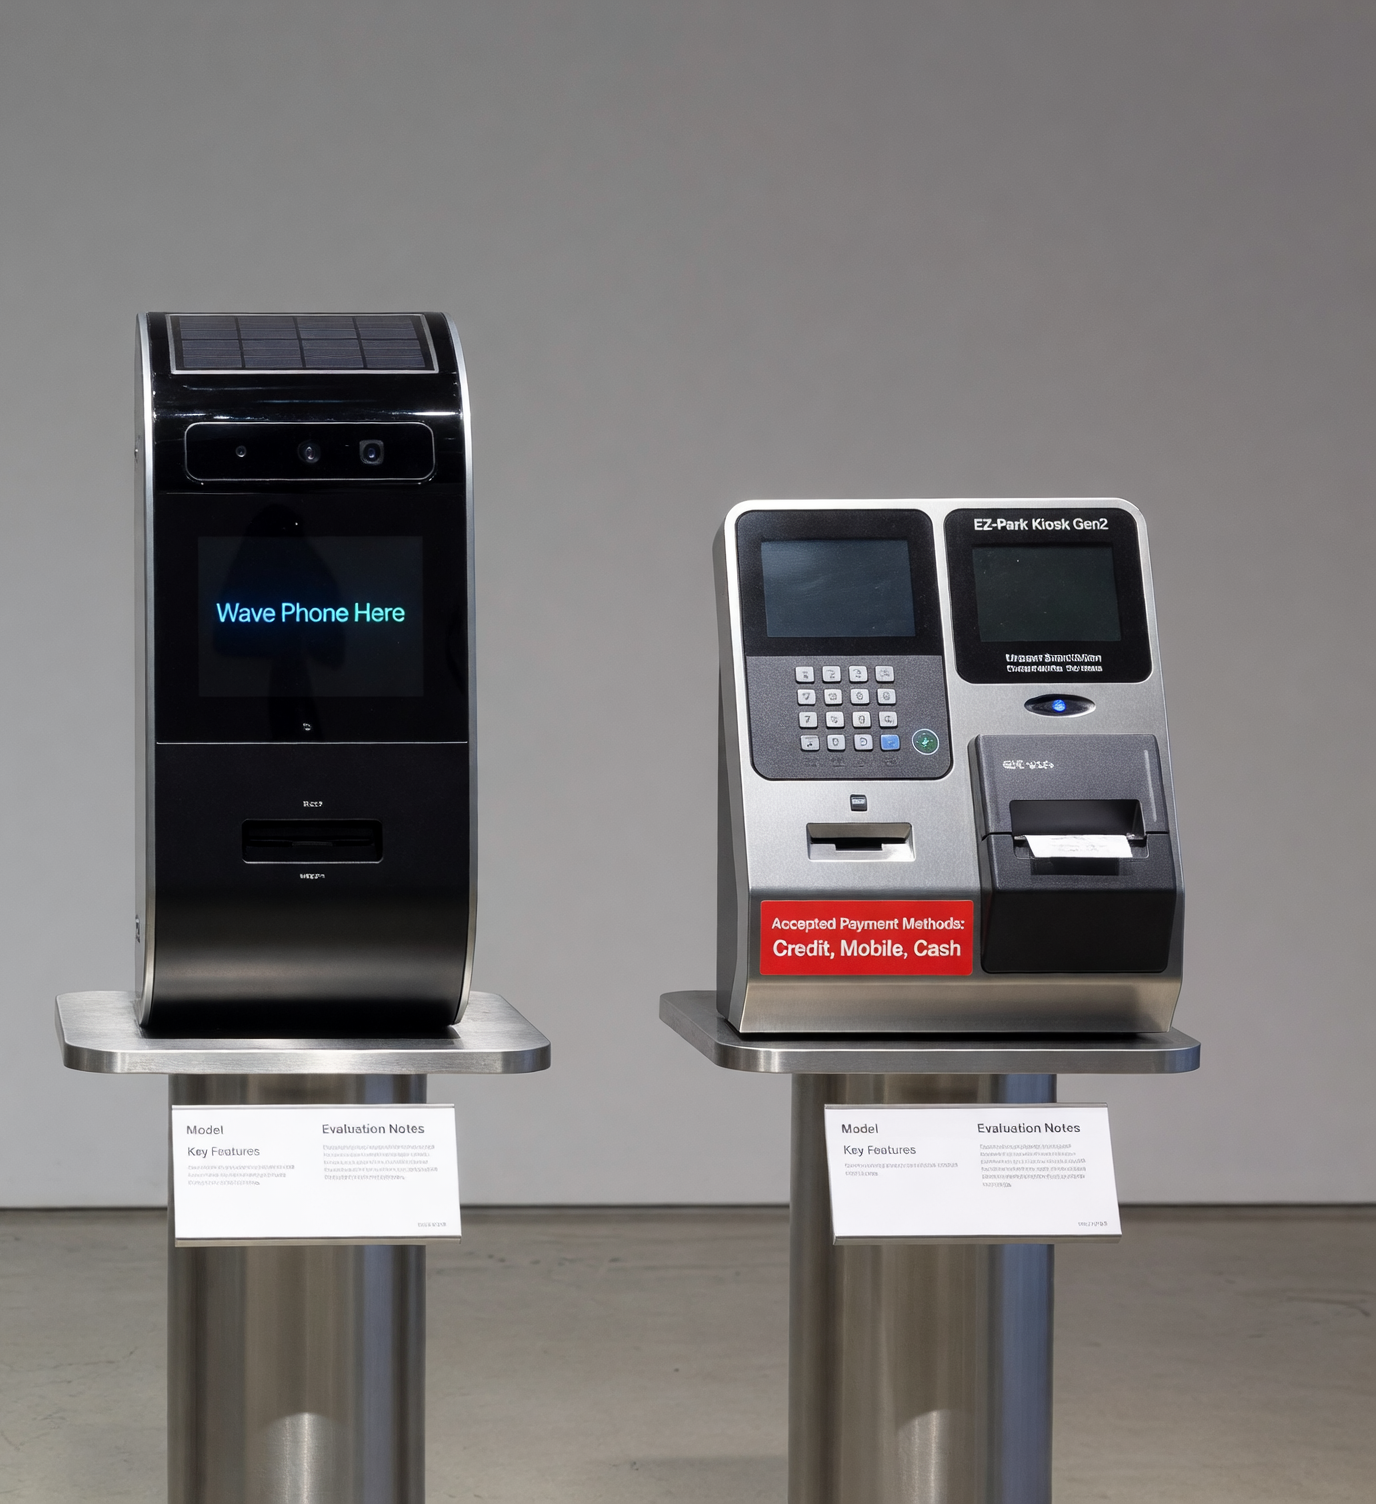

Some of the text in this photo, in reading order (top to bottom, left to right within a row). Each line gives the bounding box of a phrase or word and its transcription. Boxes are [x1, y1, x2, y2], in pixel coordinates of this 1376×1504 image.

[973, 517, 1109, 531] EZ-Park Kiosk Gen2
[216, 602, 406, 623] Wave Phone Here
[771, 916, 965, 933] Accepted Payment Methods:
[772, 939, 961, 960] Credit, Mobile, Cash
[186, 1124, 224, 1135] Model
[322, 1123, 425, 1134] Evaluation Notes
[841, 1123, 879, 1134] Model
[977, 1122, 1081, 1134] Evaluation Notes
[187, 1146, 261, 1159] Key Features
[843, 1144, 917, 1158] Key Features
